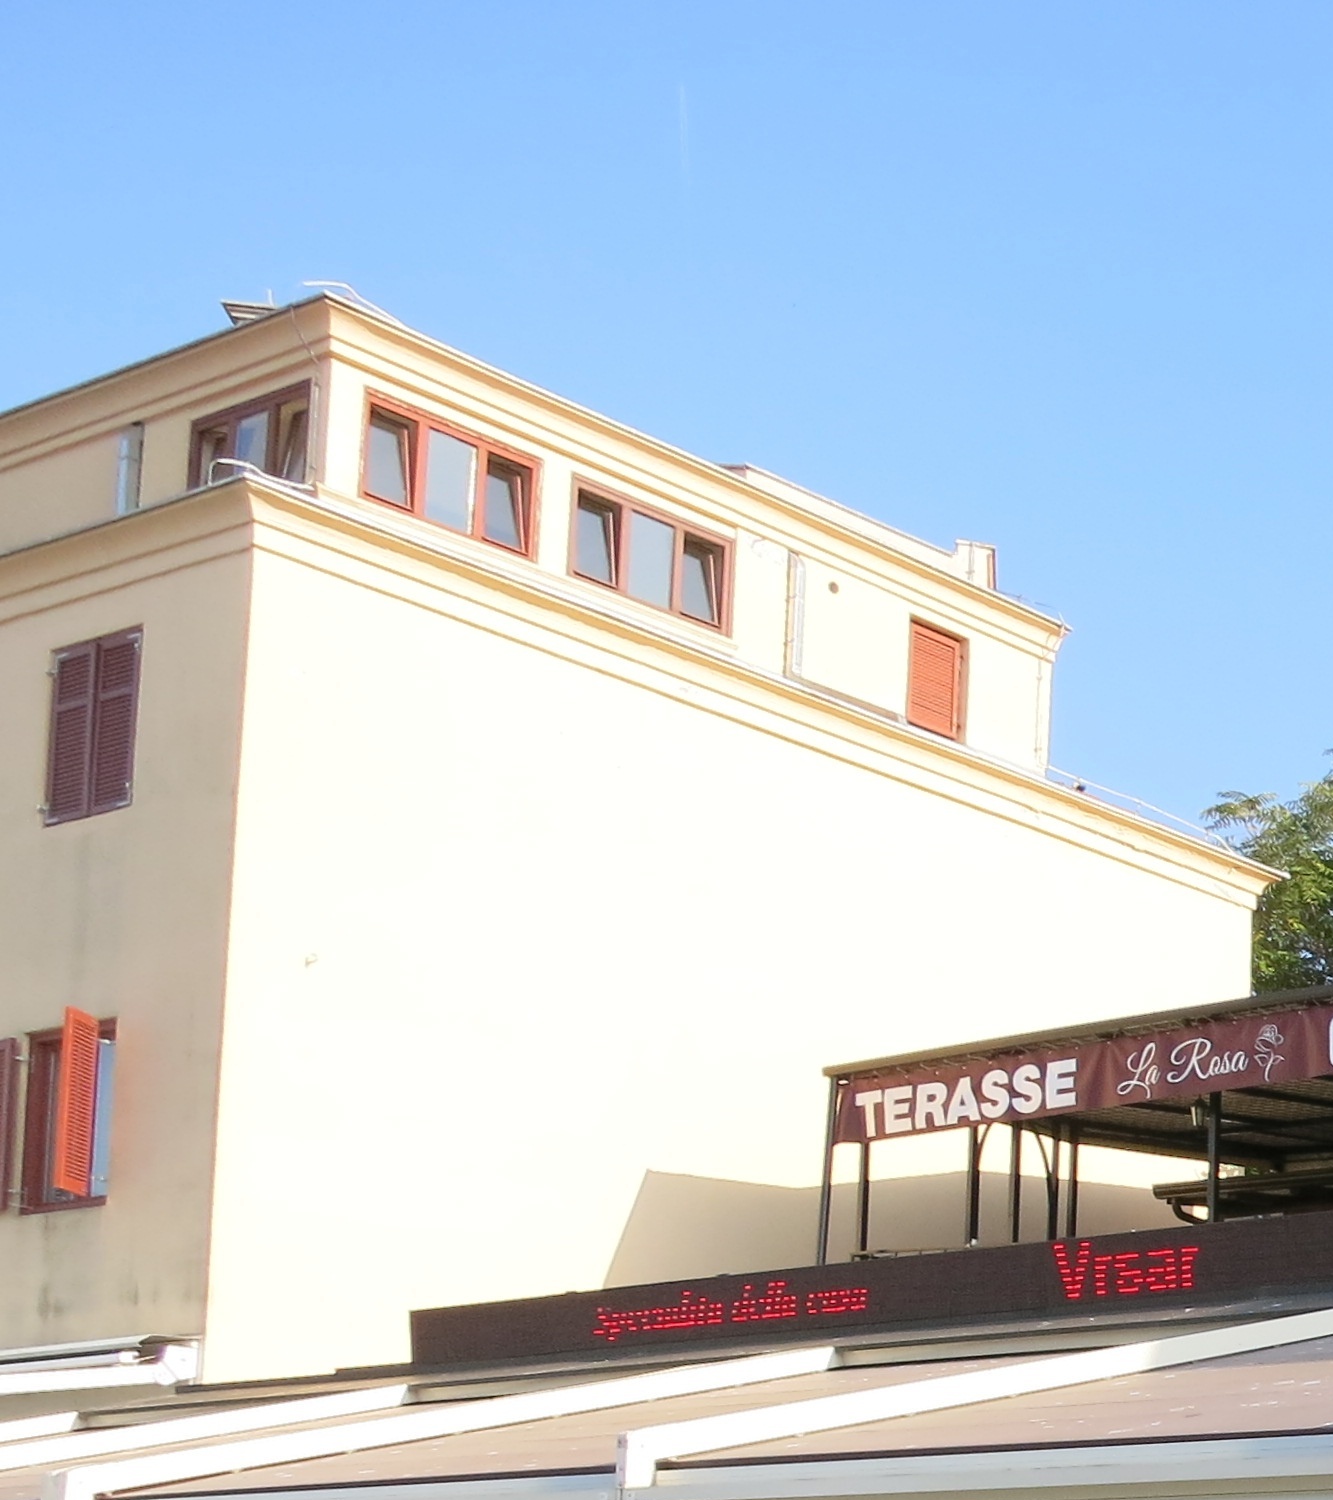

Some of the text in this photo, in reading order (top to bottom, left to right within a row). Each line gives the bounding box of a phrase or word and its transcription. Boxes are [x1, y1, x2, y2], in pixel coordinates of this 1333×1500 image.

[855, 1058, 1078, 1138] TERASSE
[1116, 1038, 1248, 1100] La Rosa
